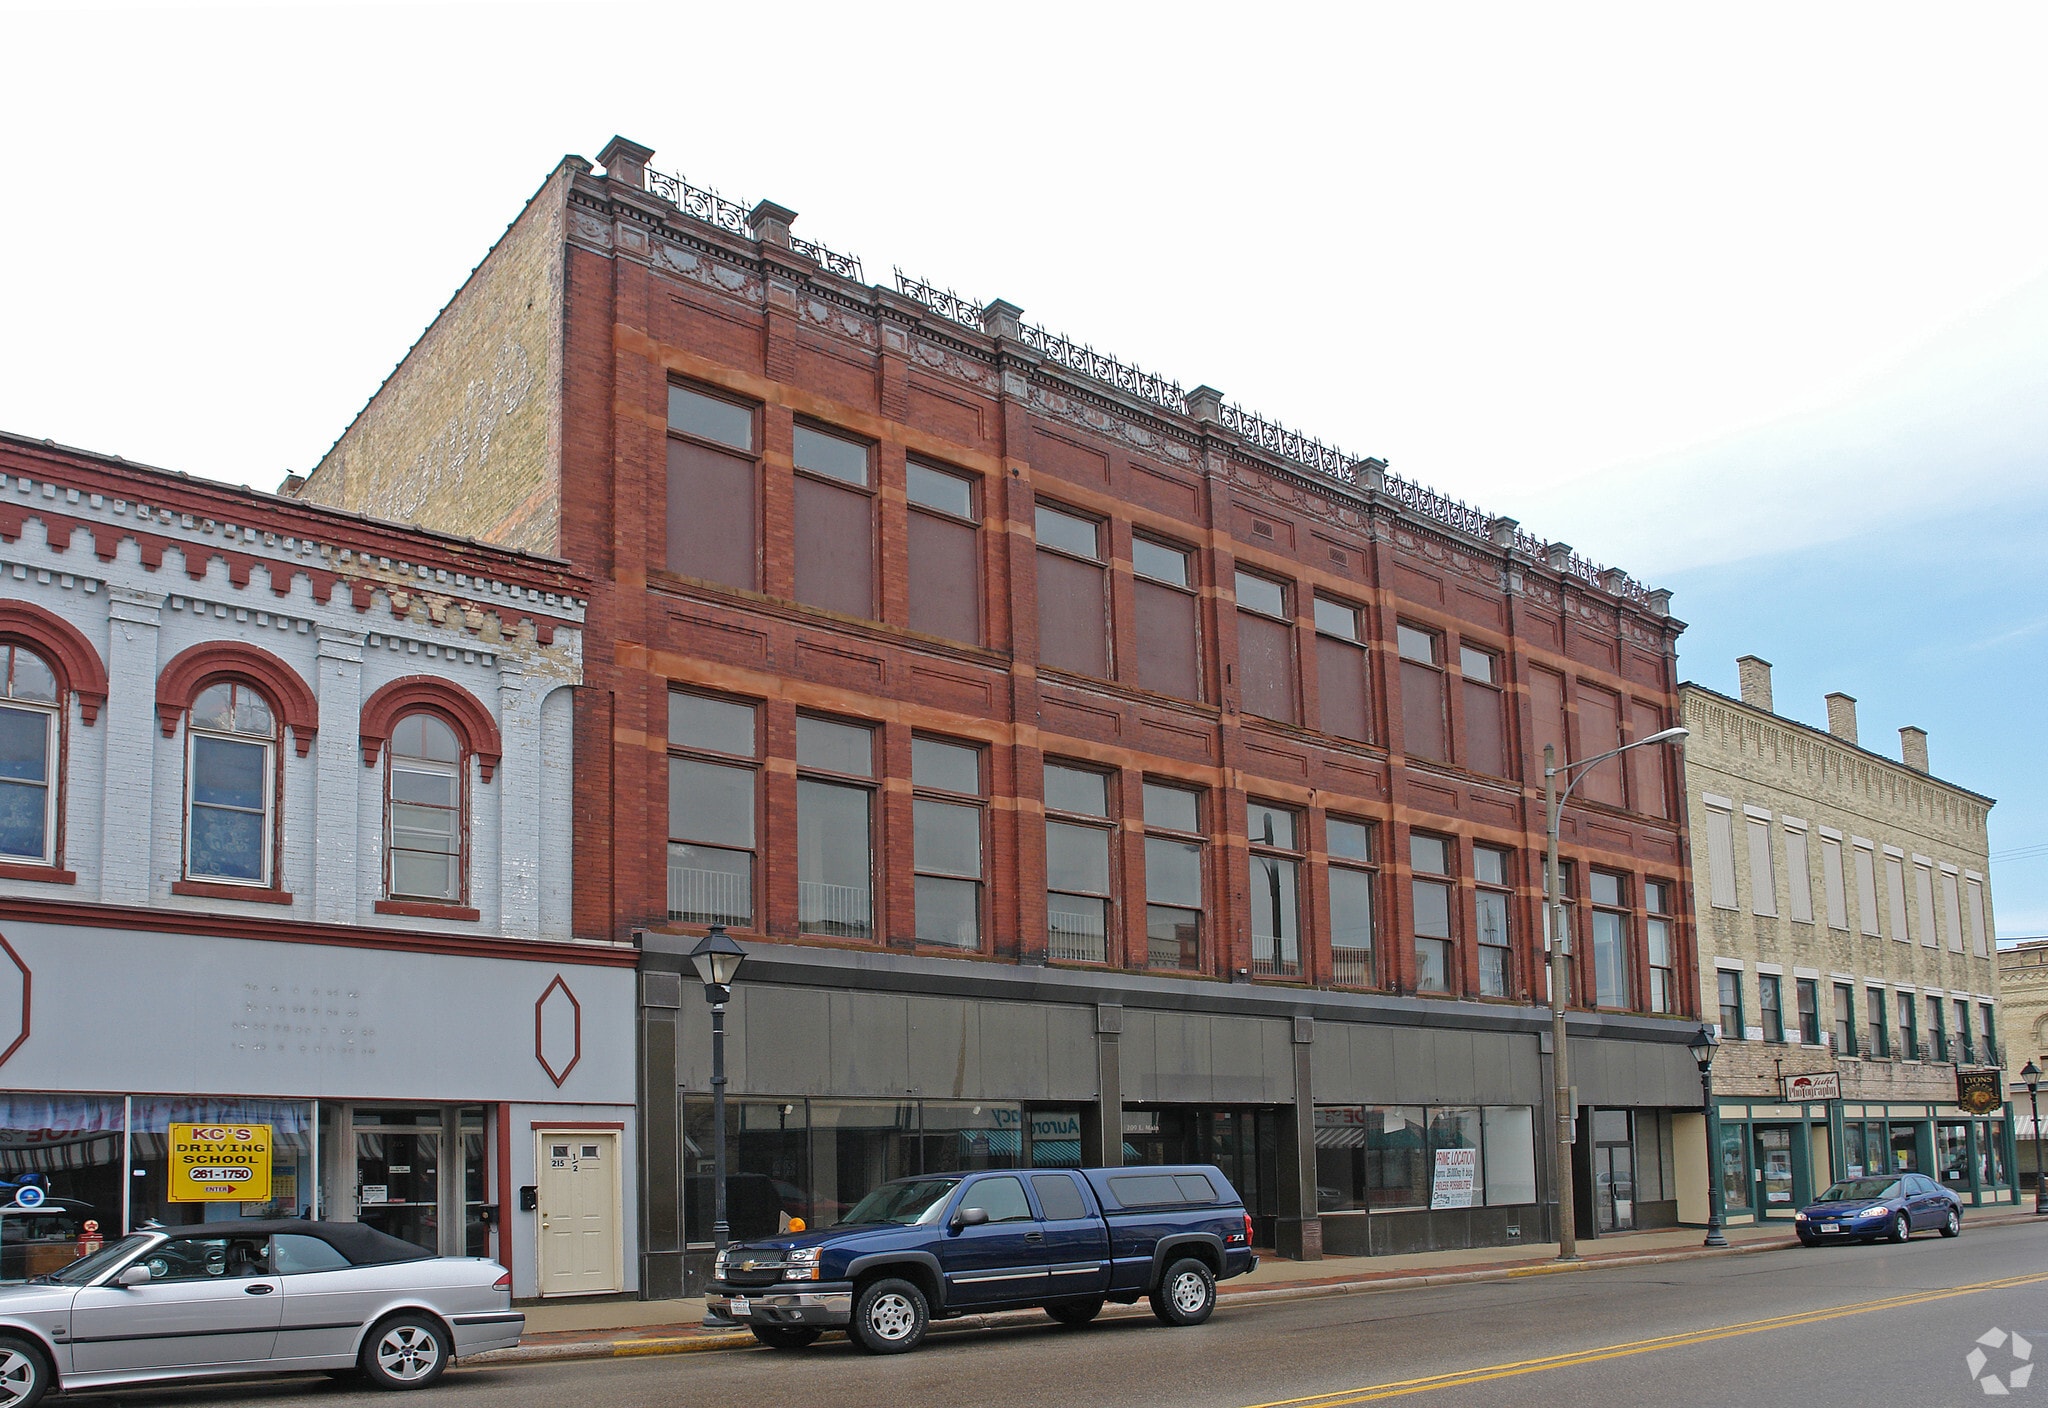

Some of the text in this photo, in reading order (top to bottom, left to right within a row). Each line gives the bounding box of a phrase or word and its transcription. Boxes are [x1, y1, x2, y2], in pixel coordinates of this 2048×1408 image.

[1964, 1076, 1993, 1084] LYONS
[191, 1127, 252, 1141] KC'S
[176, 1144, 265, 1152] DRIVING
[183, 1155, 259, 1164] SCHOOL
[1451, 1151, 1476, 1165] LOCATION
[192, 1169, 249, 1179] 261-1750
[1226, 1234, 1245, 1243] Z71
